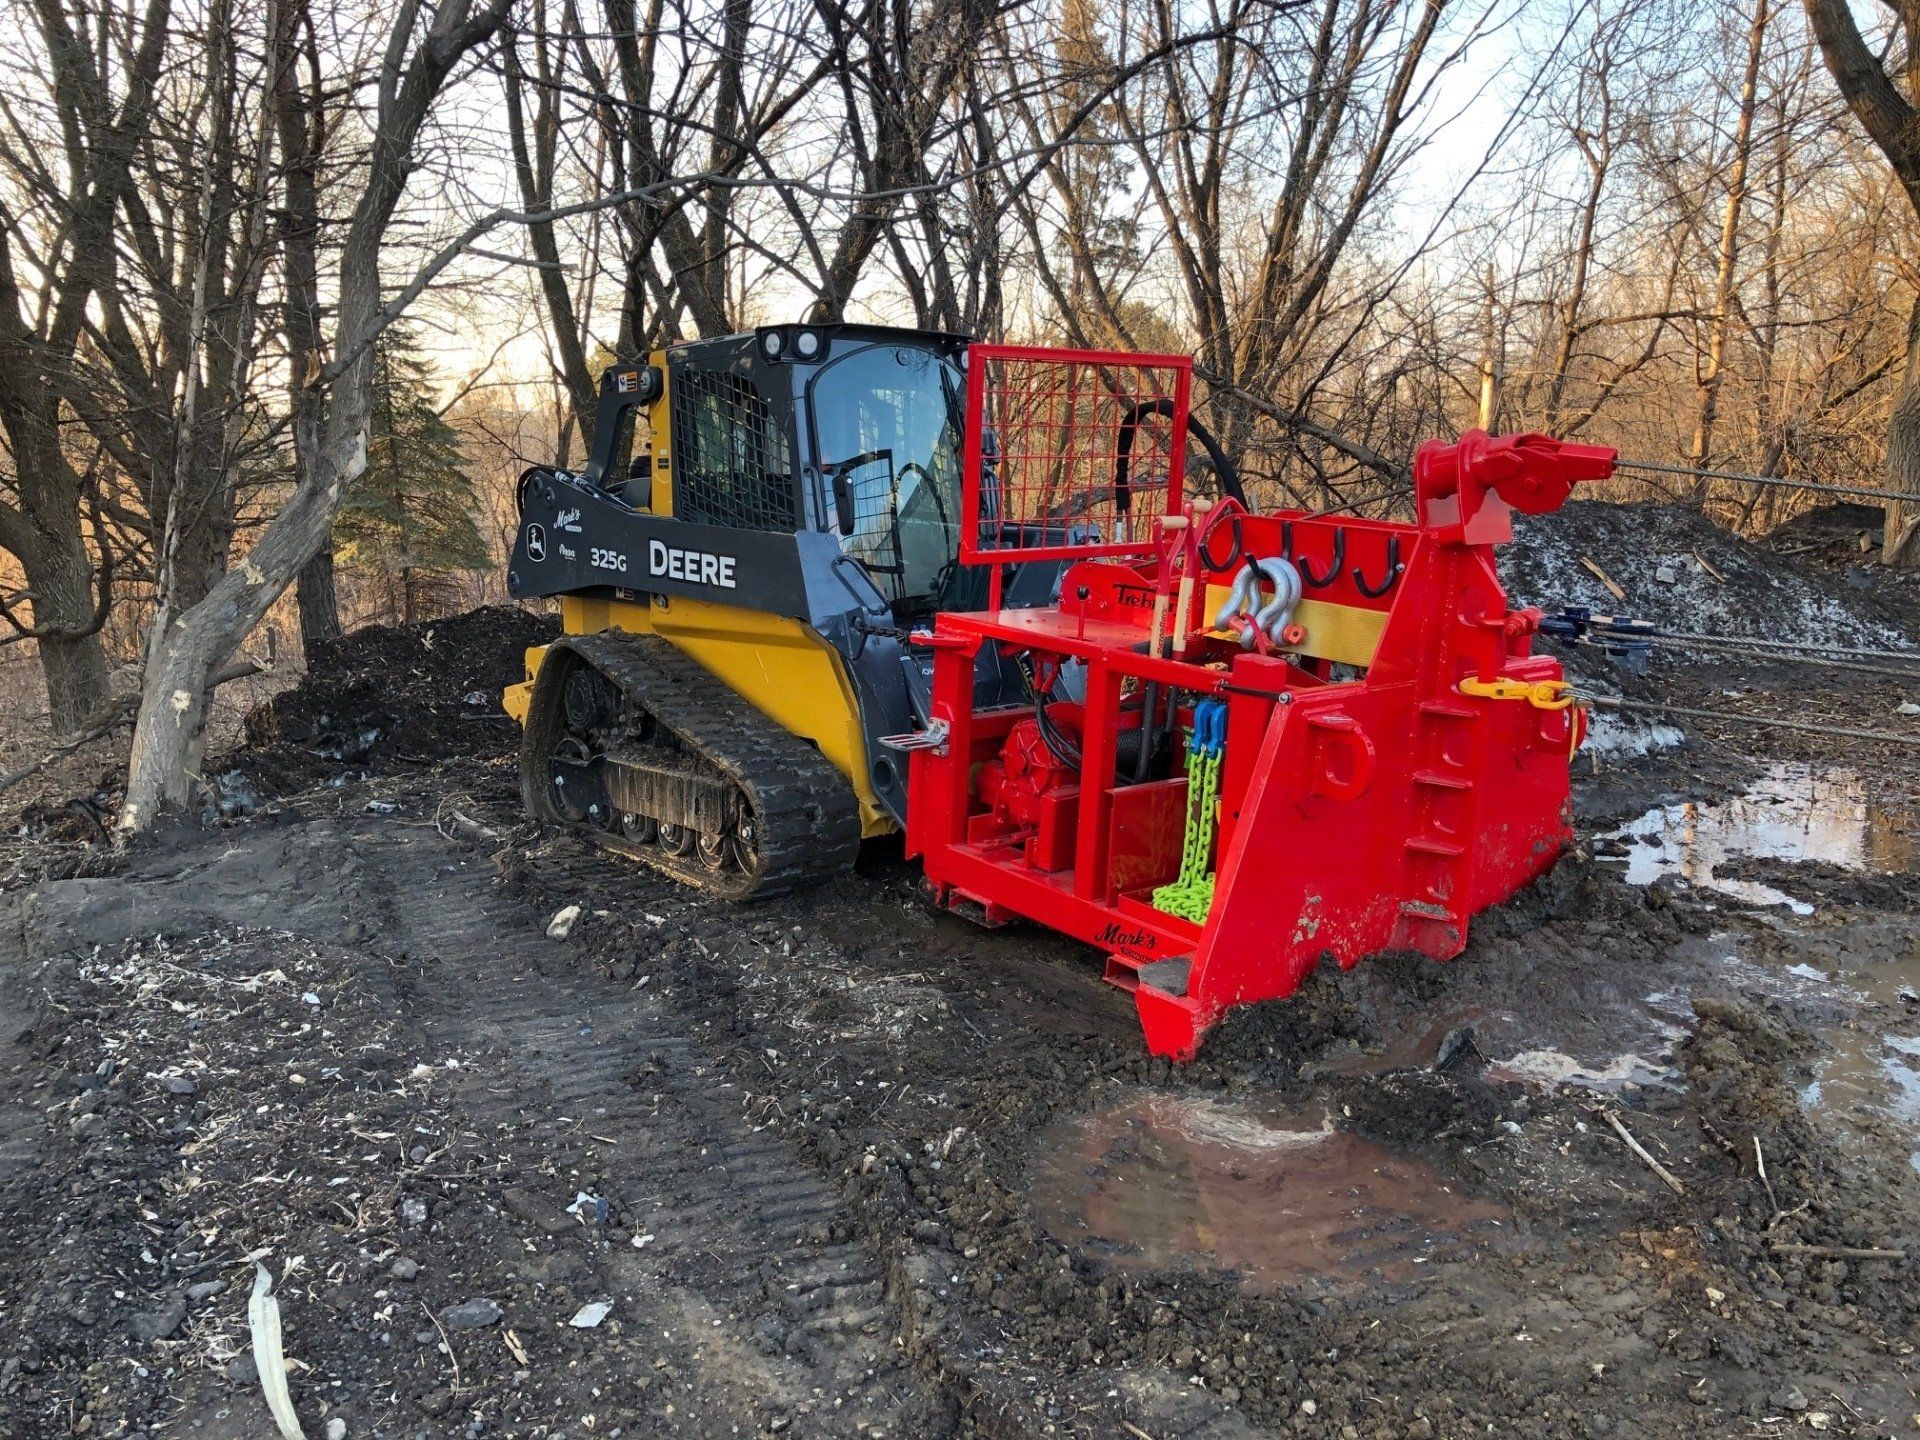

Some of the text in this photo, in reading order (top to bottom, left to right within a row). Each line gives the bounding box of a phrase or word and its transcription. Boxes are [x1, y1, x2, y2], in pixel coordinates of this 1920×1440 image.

[590, 547, 627, 572] 325G
[649, 539, 736, 589] DEERE
[1094, 922, 1157, 949] Mark's
